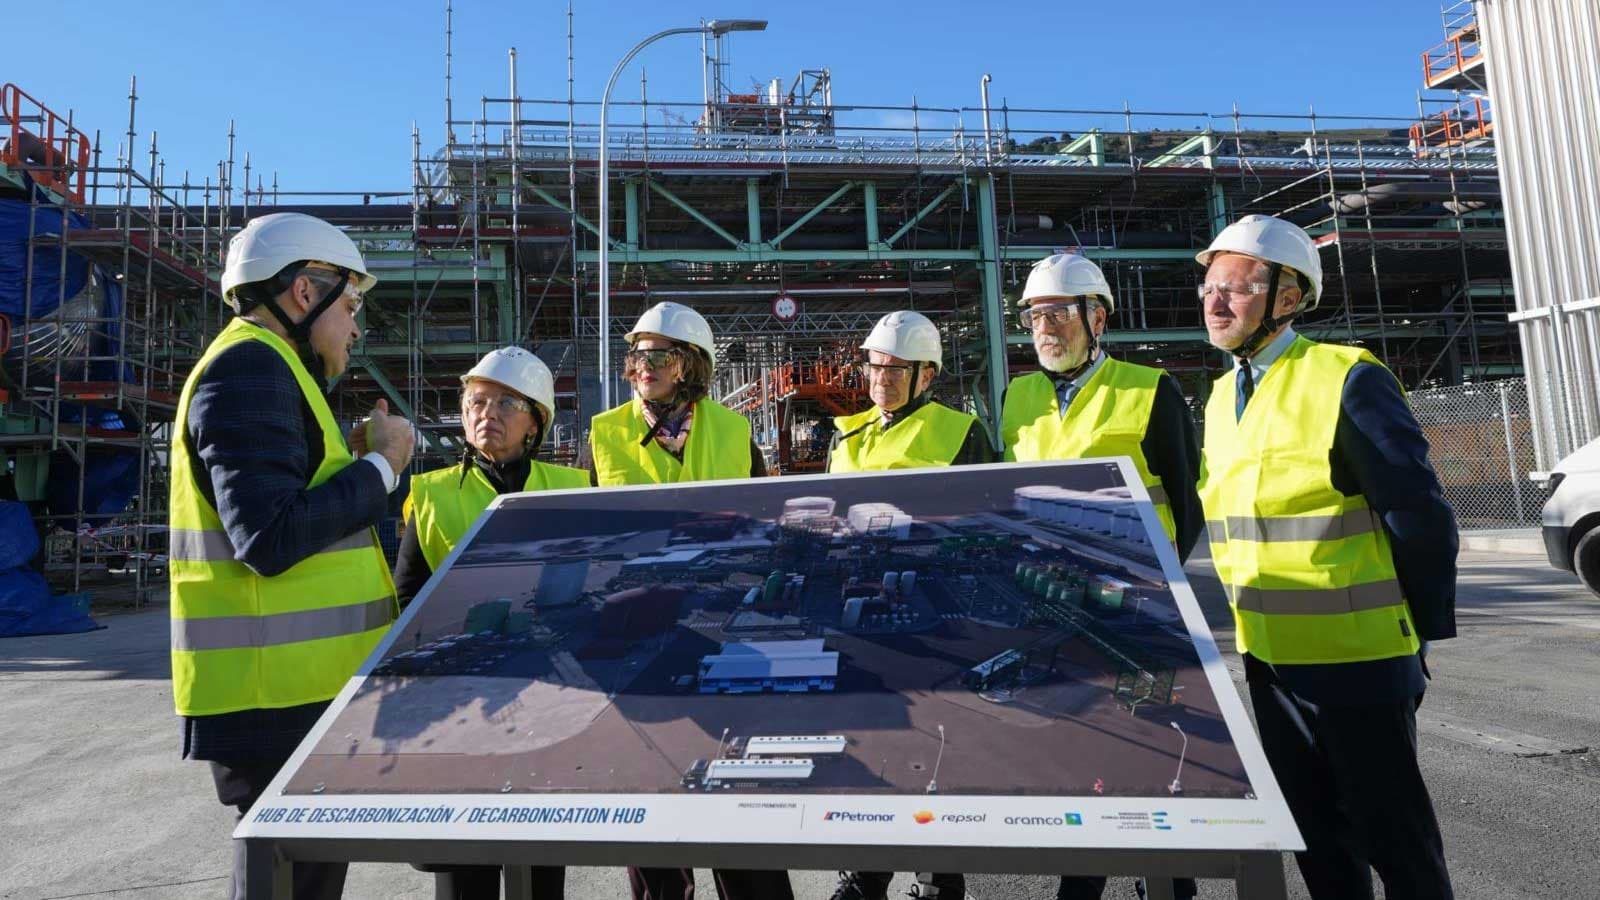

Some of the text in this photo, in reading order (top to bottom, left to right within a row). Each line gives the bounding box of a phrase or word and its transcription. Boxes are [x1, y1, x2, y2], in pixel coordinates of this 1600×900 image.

[253, 804, 647, 824] HUB DE DESCARBONIZACIÓN / DECARBONISATION HUB
[841, 811, 896, 822] Petronor
[941, 813, 987, 824] repsol
[1004, 815, 1064, 826] aramco
